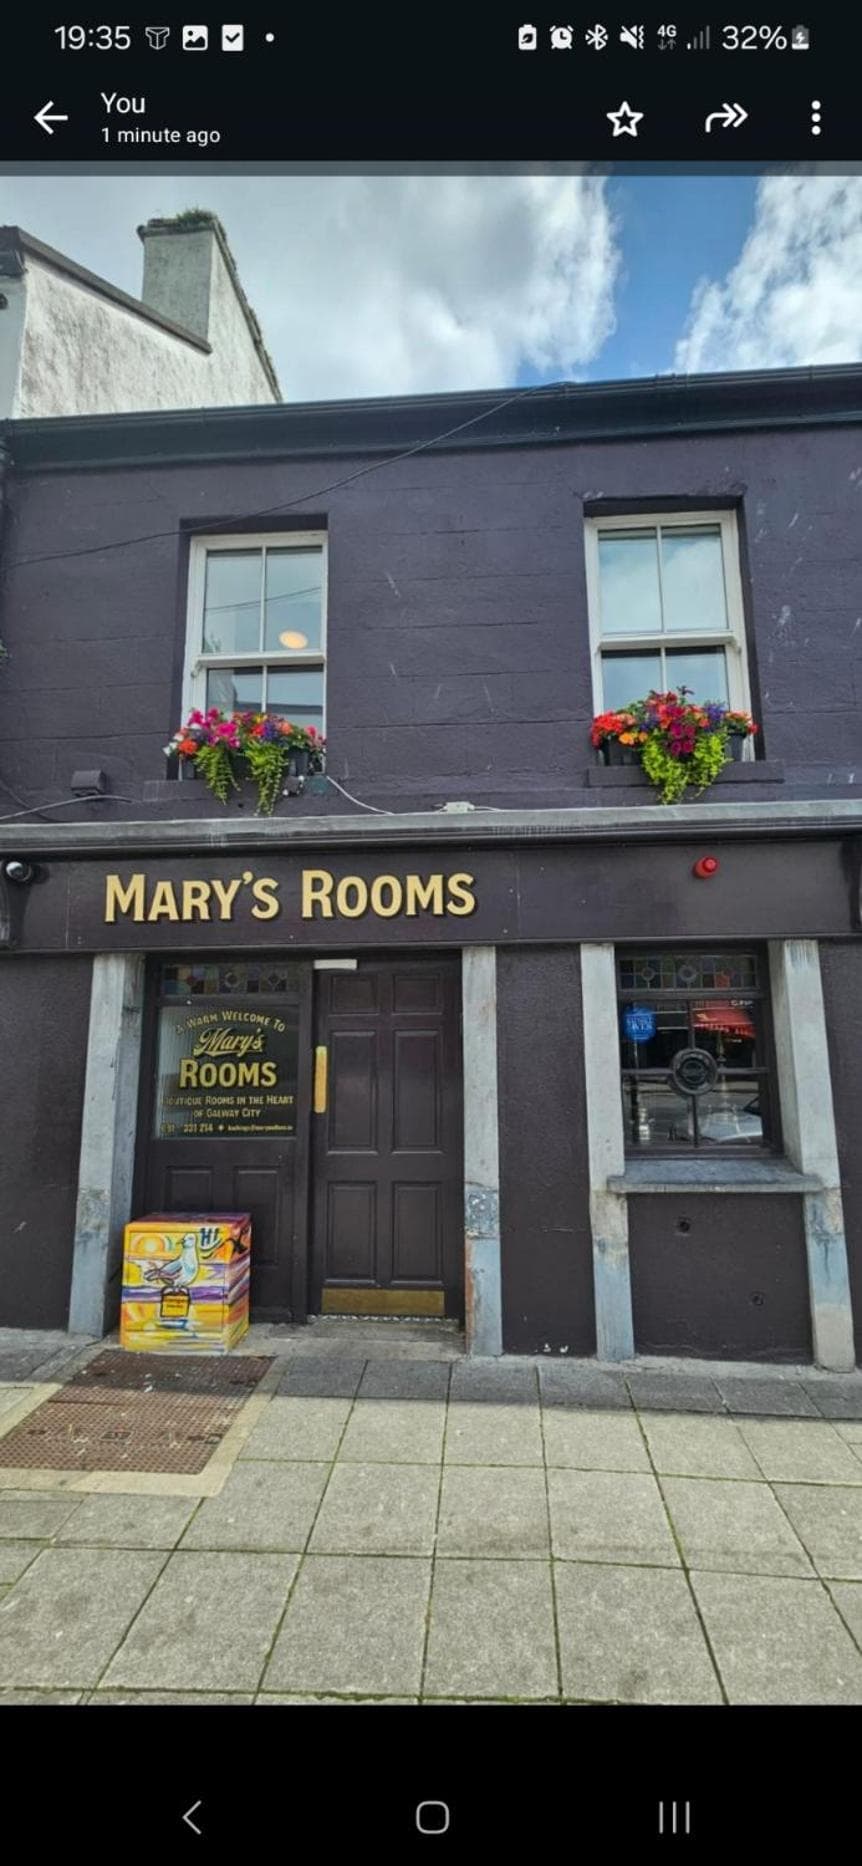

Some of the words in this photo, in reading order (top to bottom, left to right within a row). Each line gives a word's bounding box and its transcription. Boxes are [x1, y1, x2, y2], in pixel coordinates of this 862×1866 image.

[104, 871, 280, 923] MARY'S
[301, 869, 476, 919] ROOMS
[186, 1013, 218, 1029] WARM
[222, 1010, 271, 1027] WELCOME
[273, 1018, 286, 1033] TO
[193, 1027, 264, 1058] Mary's
[179, 1058, 277, 1088] ROOMS
[205, 1095, 235, 1106] ROOMS
[236, 1096, 246, 1105] IN
[249, 1096, 264, 1105] THE
[266, 1094, 294, 1106] HEART
[207, 1107, 239, 1118] GALWAY
[241, 1107, 261, 1118] CITY
